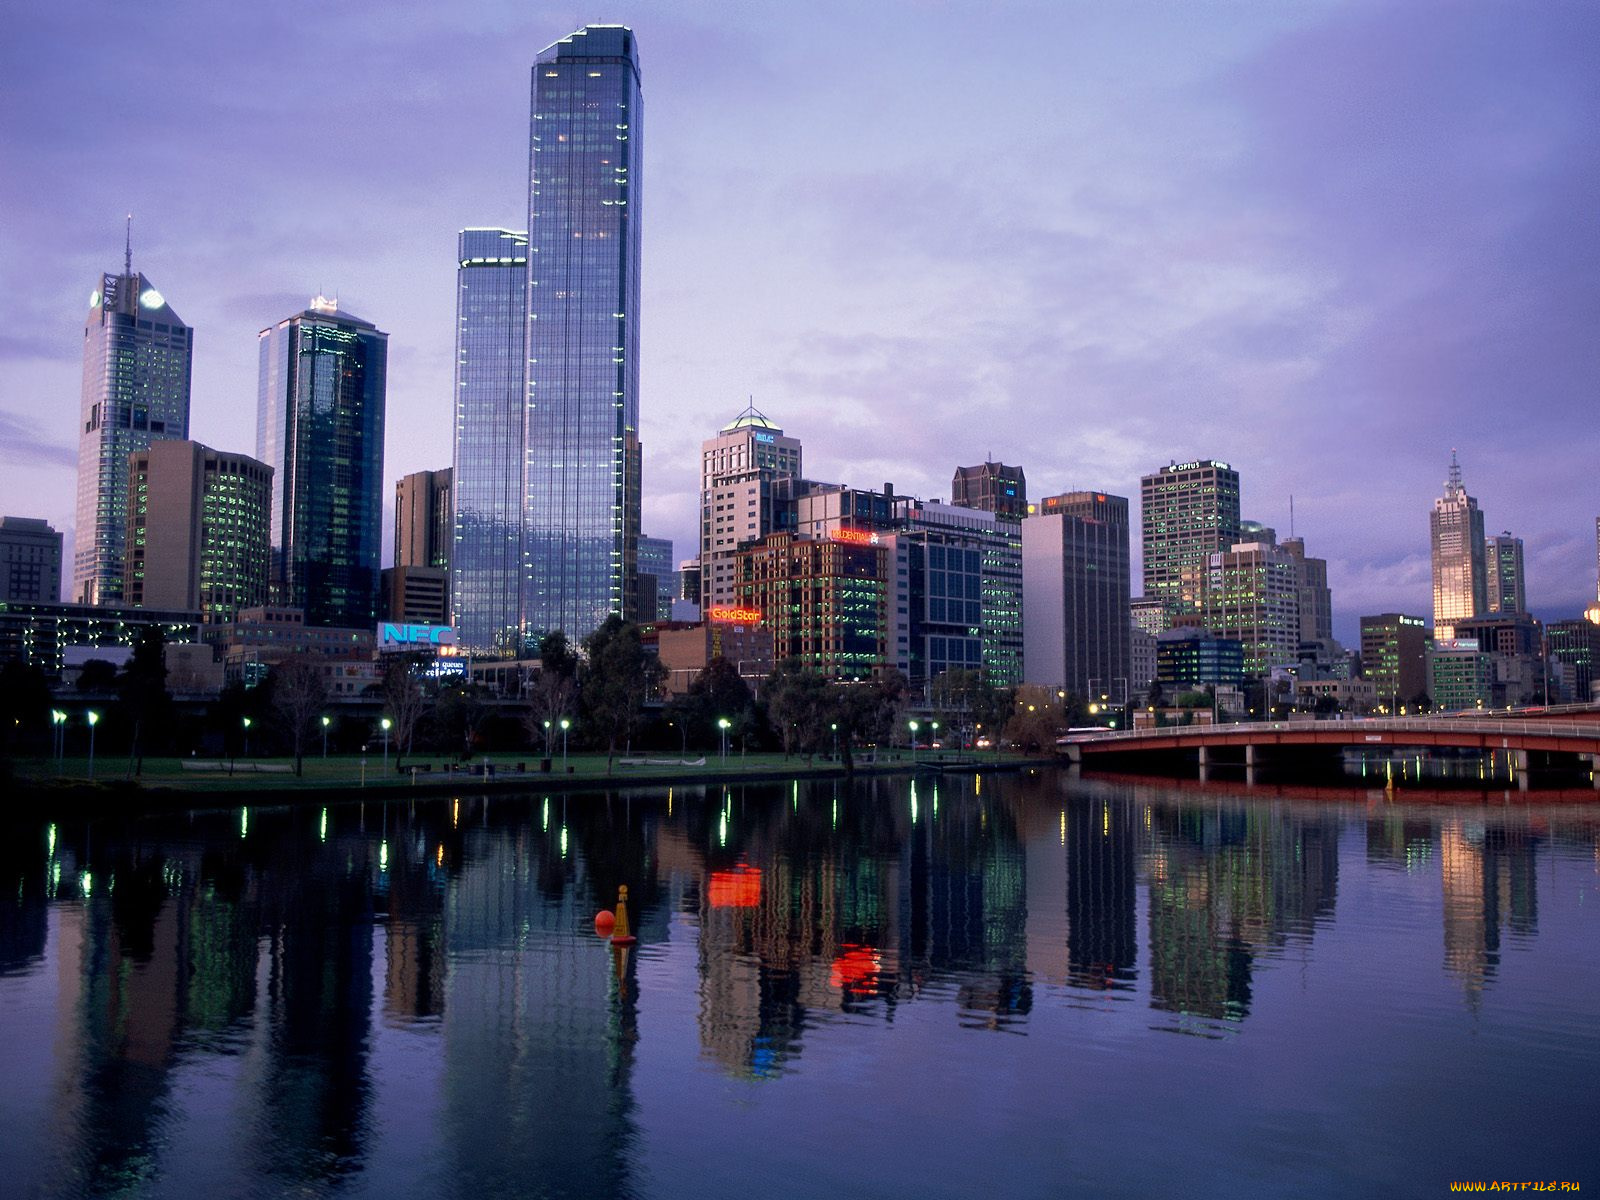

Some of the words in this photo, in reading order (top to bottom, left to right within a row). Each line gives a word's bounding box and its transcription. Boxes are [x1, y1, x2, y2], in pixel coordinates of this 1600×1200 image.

[1178, 461, 1200, 471] OPTUS
[712, 608, 760, 621] GoldStar
[384, 624, 452, 645] NEC
[442, 662, 464, 670] queues
